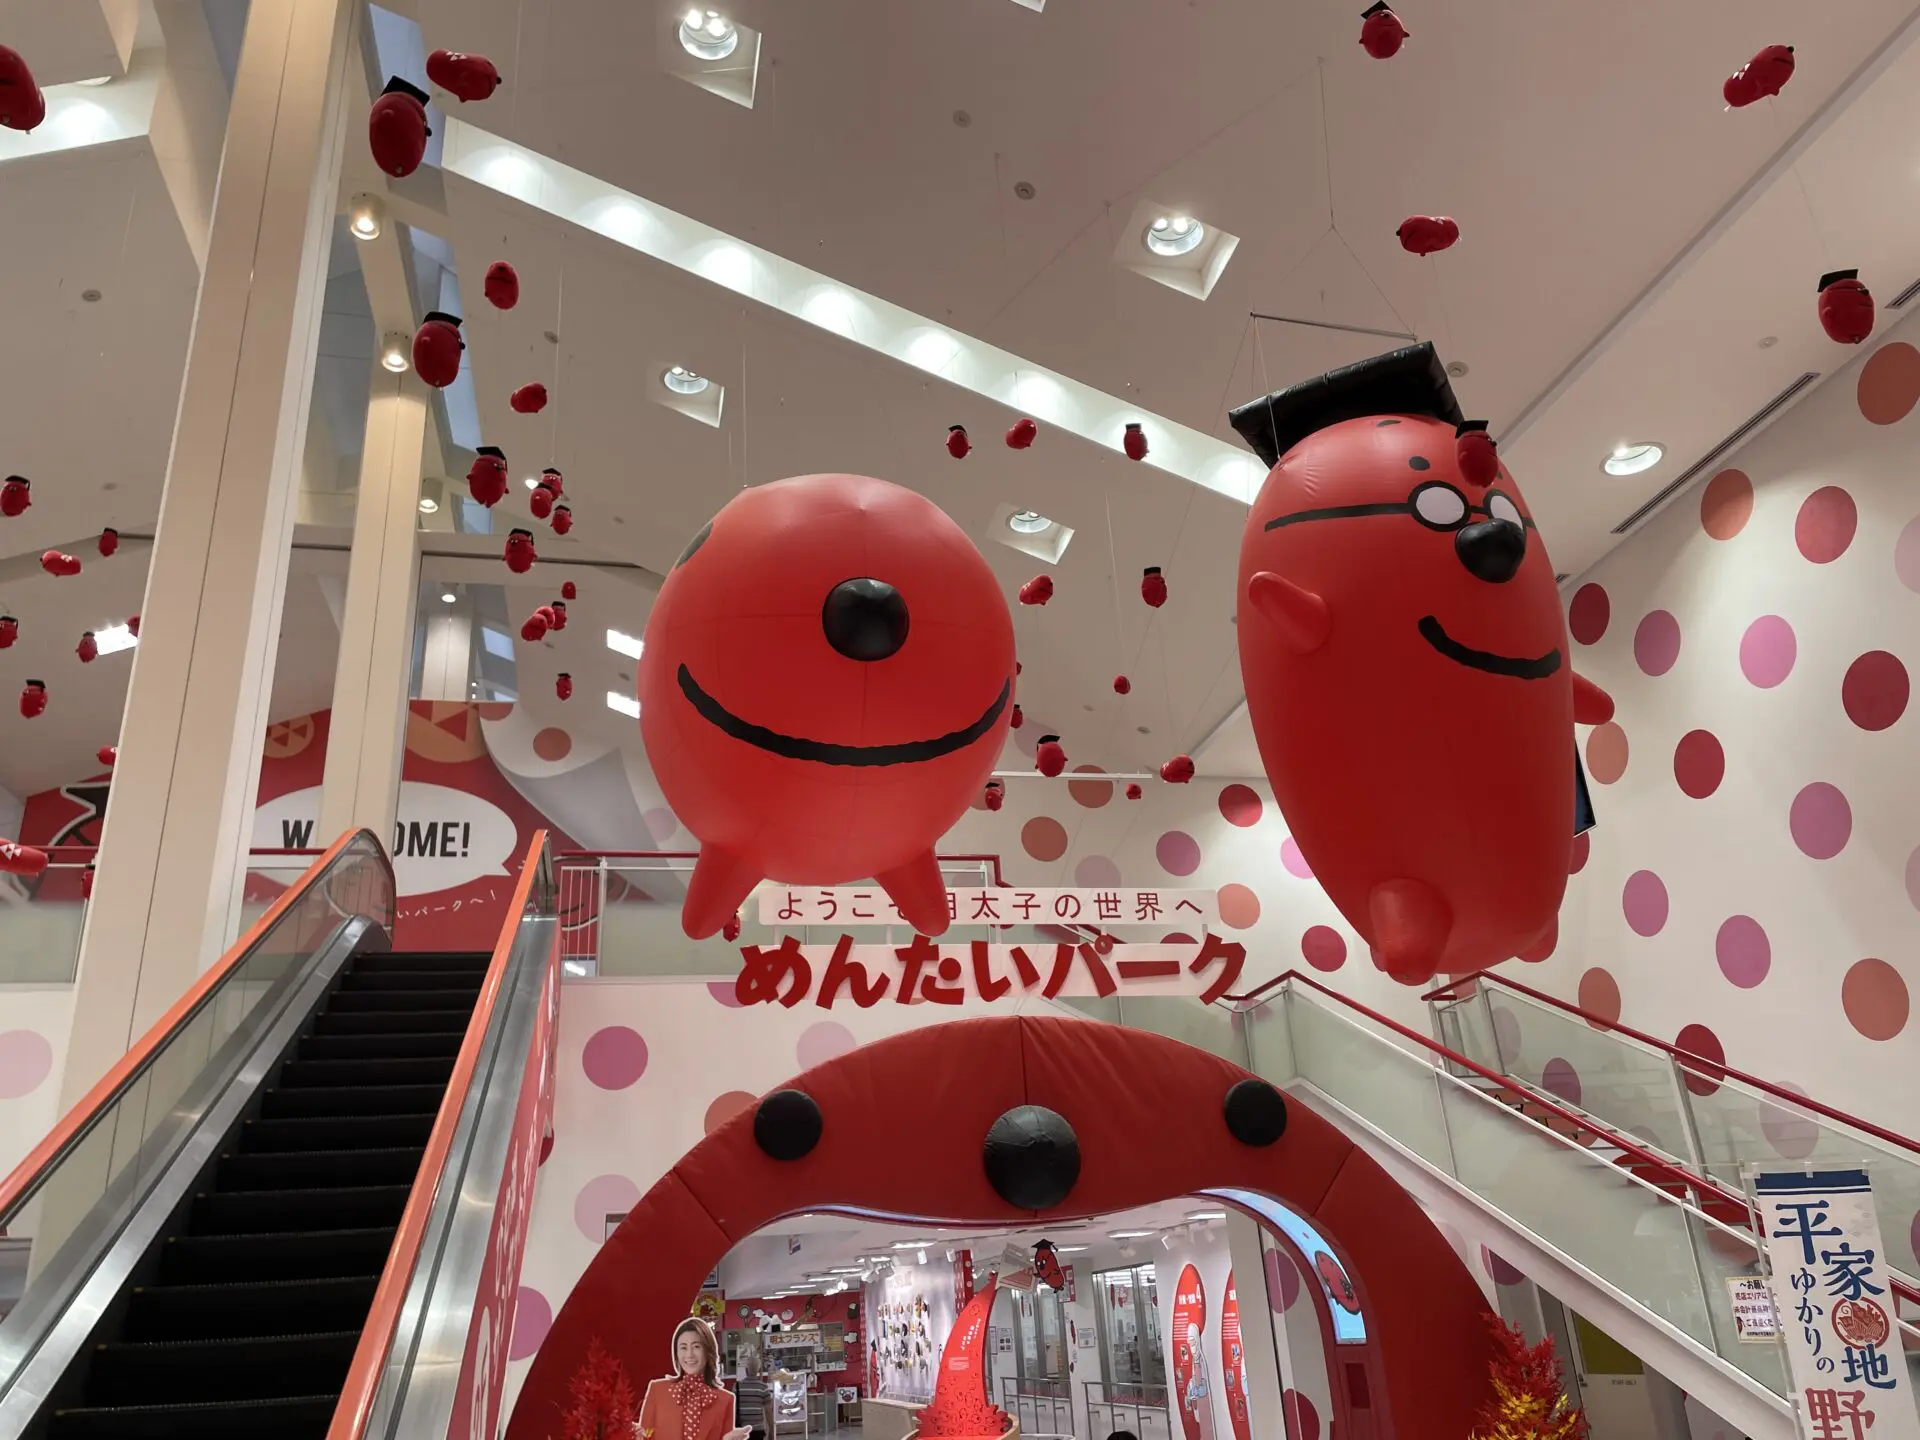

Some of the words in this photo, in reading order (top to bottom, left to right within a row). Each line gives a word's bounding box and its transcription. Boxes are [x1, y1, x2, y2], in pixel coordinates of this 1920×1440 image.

[735, 933, 1247, 1010] めんたいパーク
